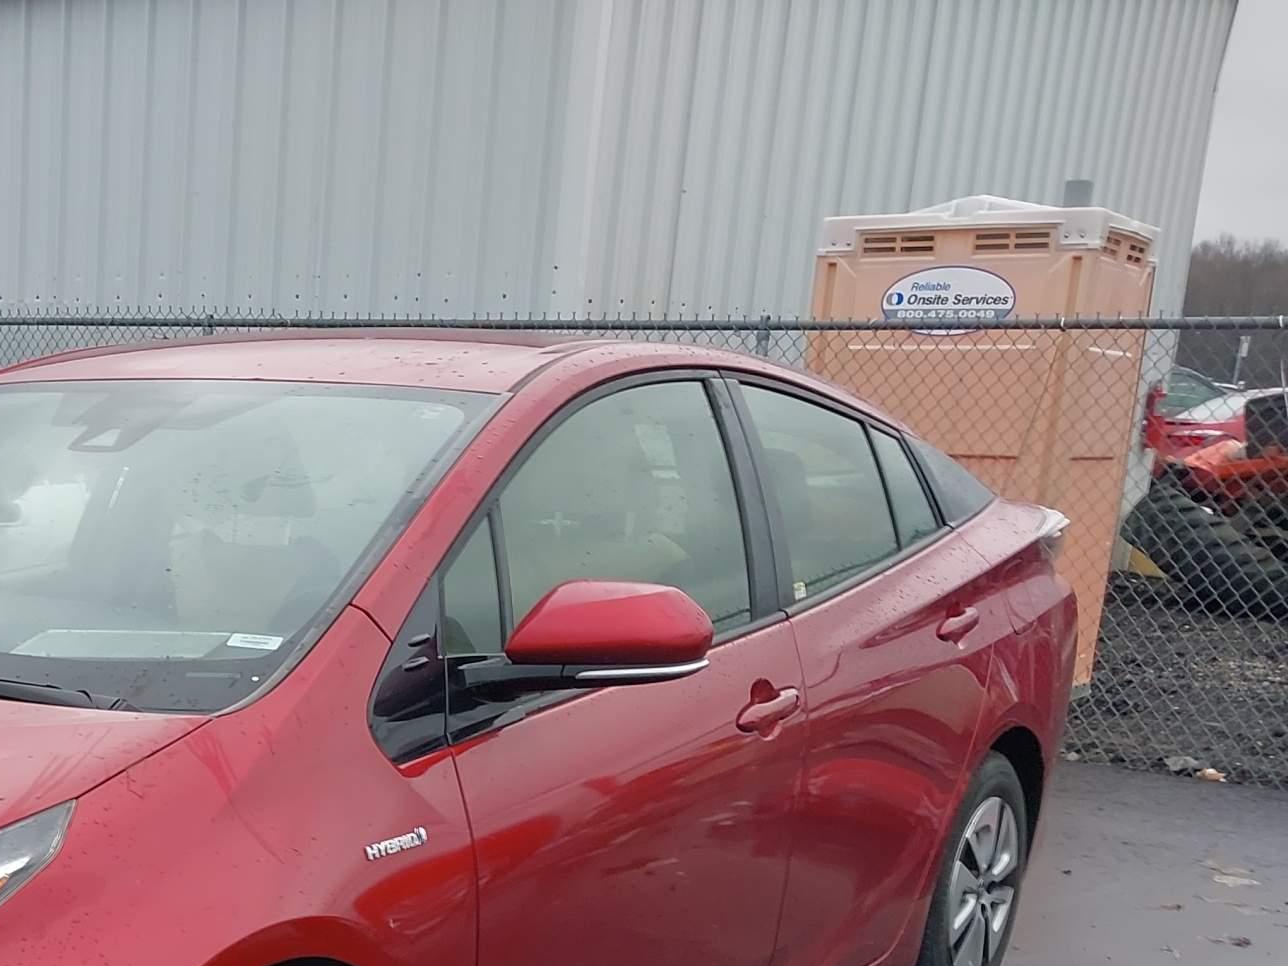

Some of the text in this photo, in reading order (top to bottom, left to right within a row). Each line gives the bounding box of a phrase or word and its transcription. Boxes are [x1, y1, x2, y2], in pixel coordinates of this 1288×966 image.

[911, 282, 951, 291] Reliable
[907, 294, 1009, 305] Onsite Services
[897, 309, 995, 318] 800.475.0049
[364, 832, 421, 861] HYBRID
